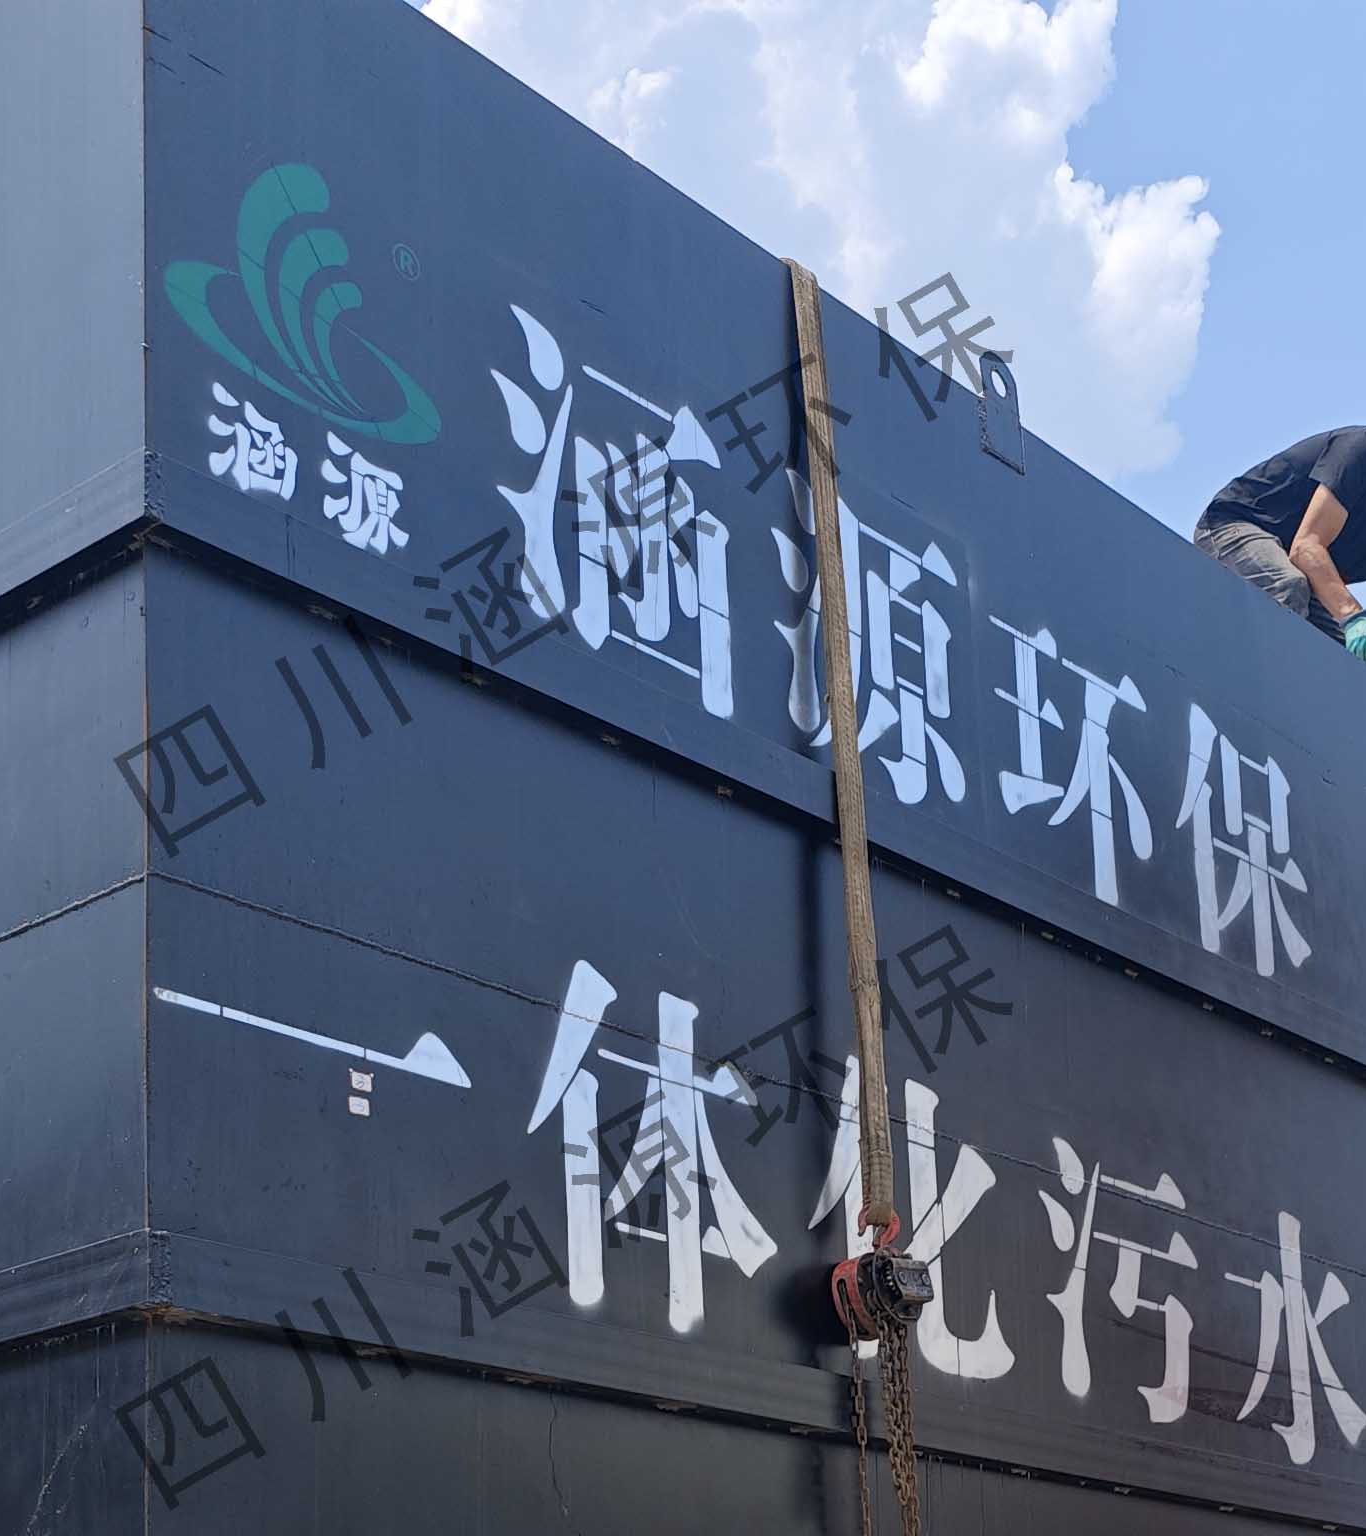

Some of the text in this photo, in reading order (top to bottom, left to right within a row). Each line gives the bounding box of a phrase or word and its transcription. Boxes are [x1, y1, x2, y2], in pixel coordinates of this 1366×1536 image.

[207, 381, 410, 555] 涵源
[490, 303, 1313, 977] 涵源环保
